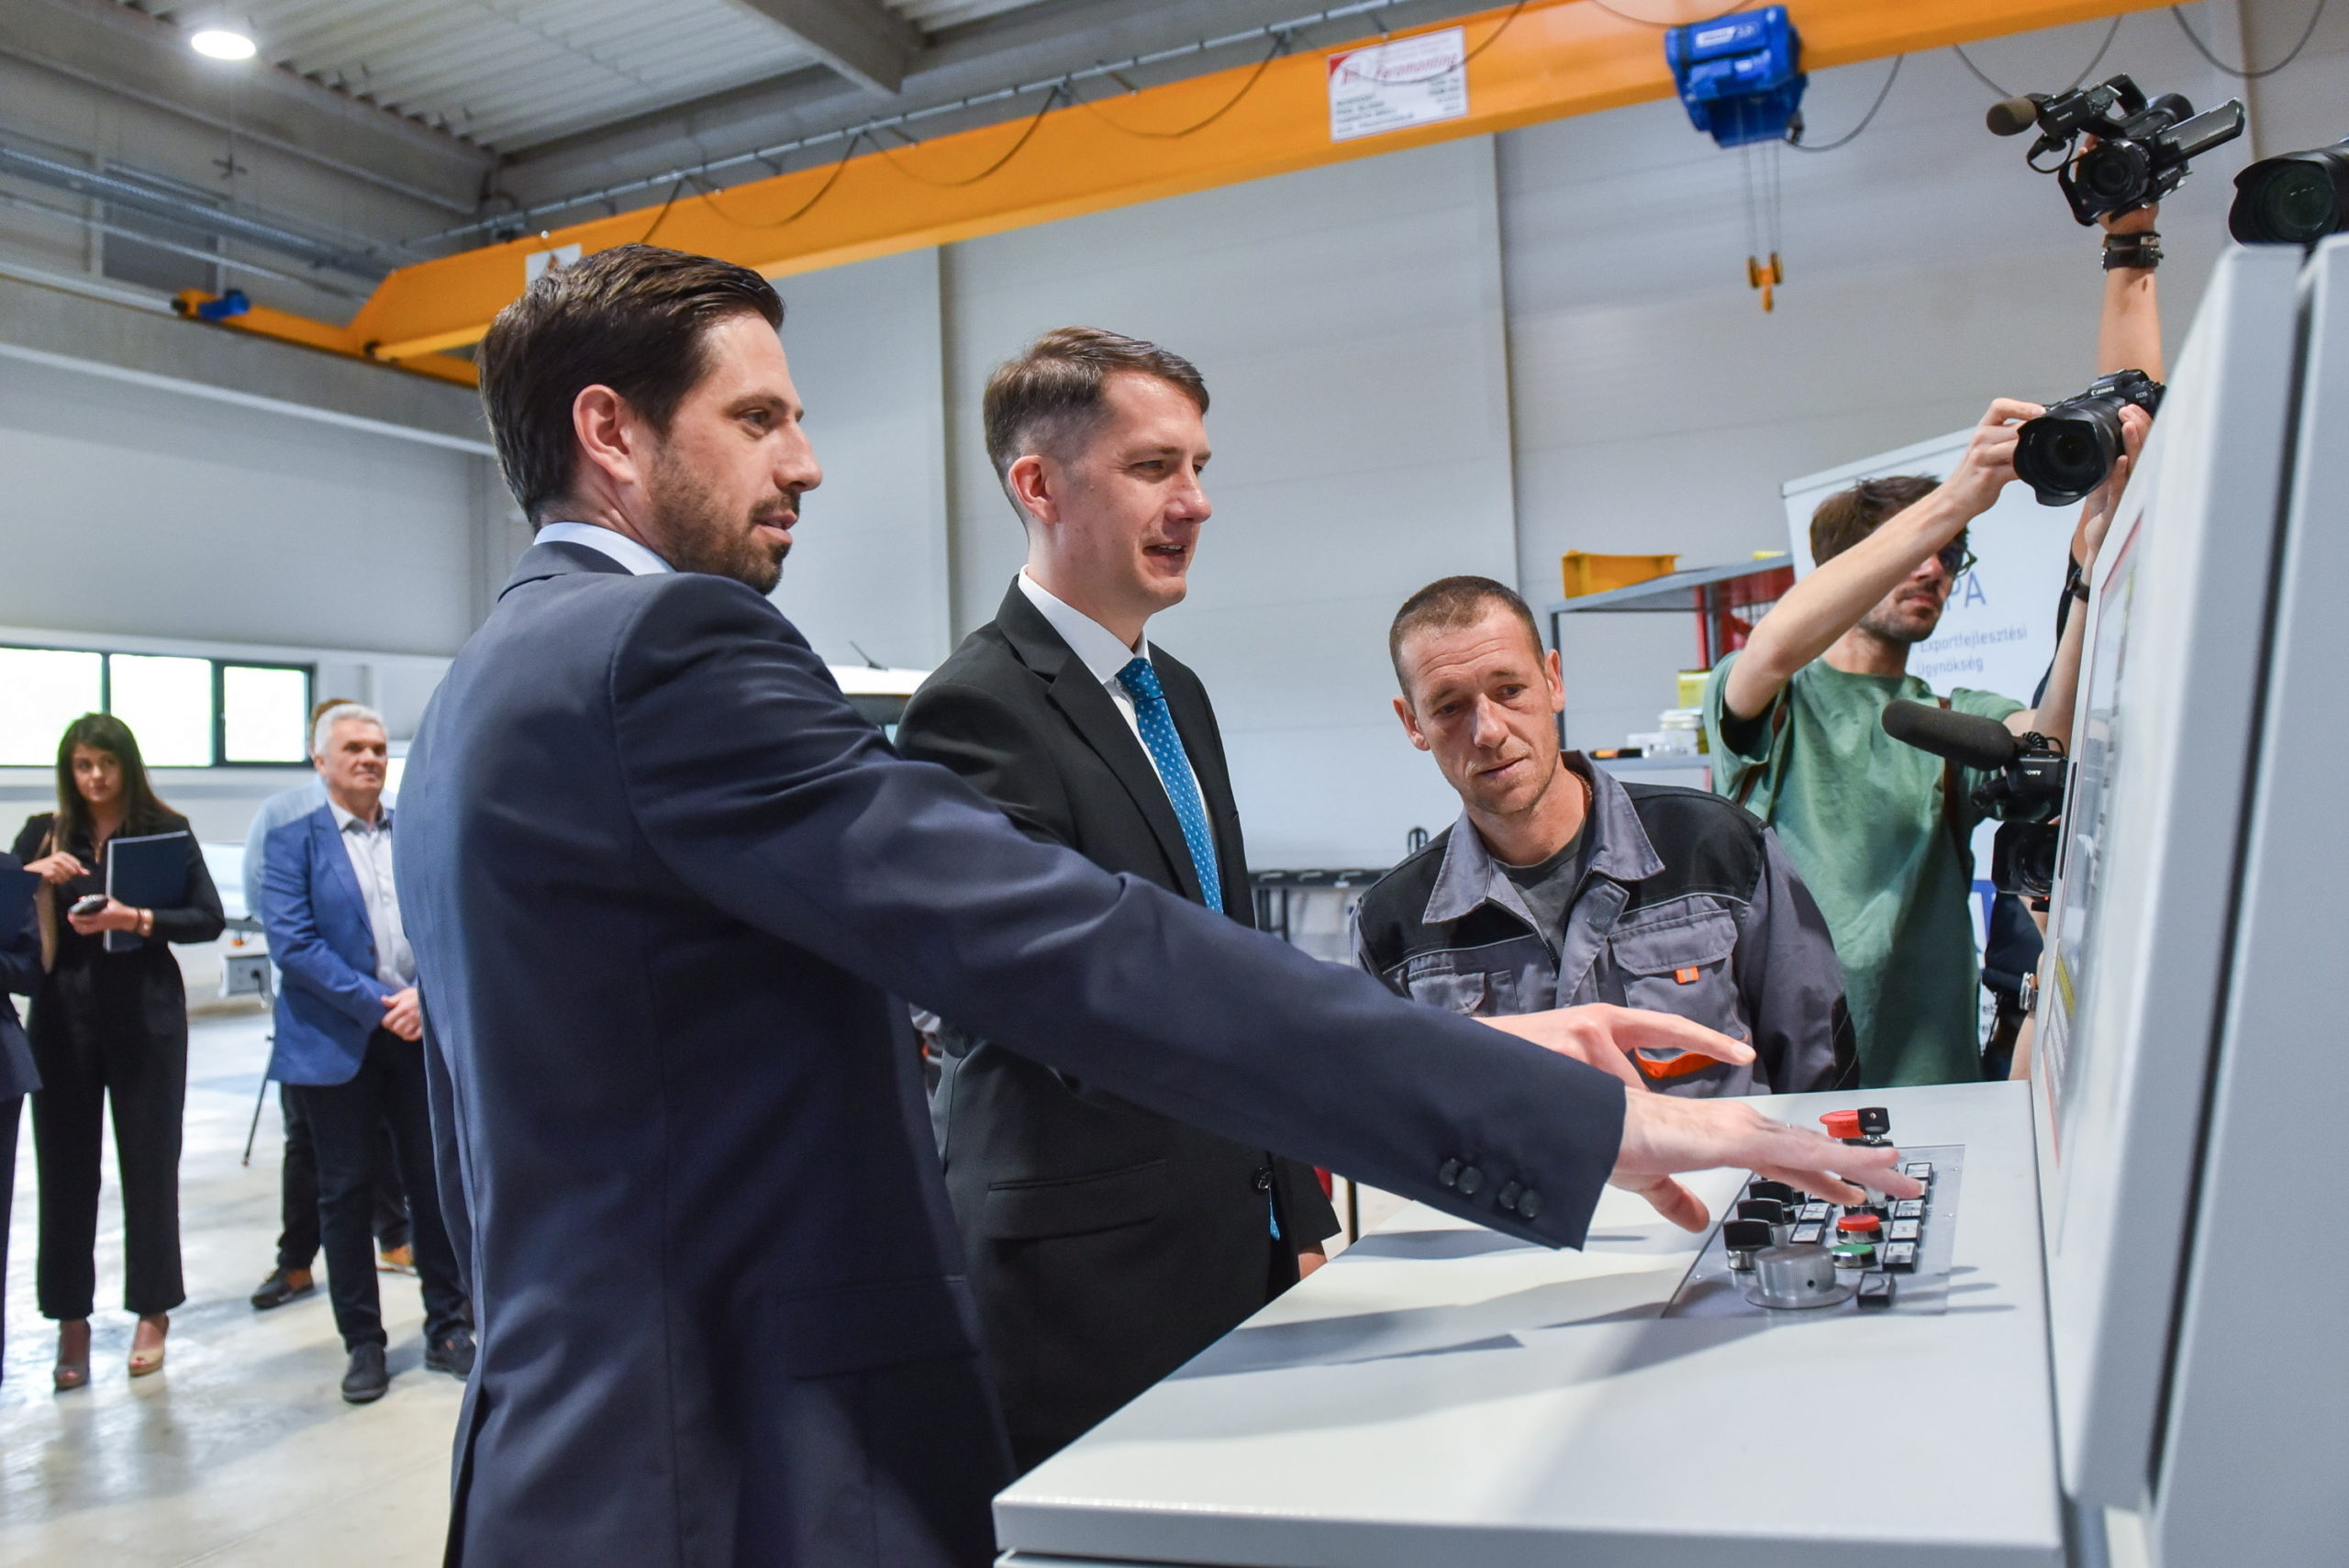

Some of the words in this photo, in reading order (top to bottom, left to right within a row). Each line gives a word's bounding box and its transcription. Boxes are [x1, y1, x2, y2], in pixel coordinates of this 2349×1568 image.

[2091, 385, 2115, 395] Canon
[2135, 391, 2148, 399] EOS
[1944, 571, 1987, 610] PA
